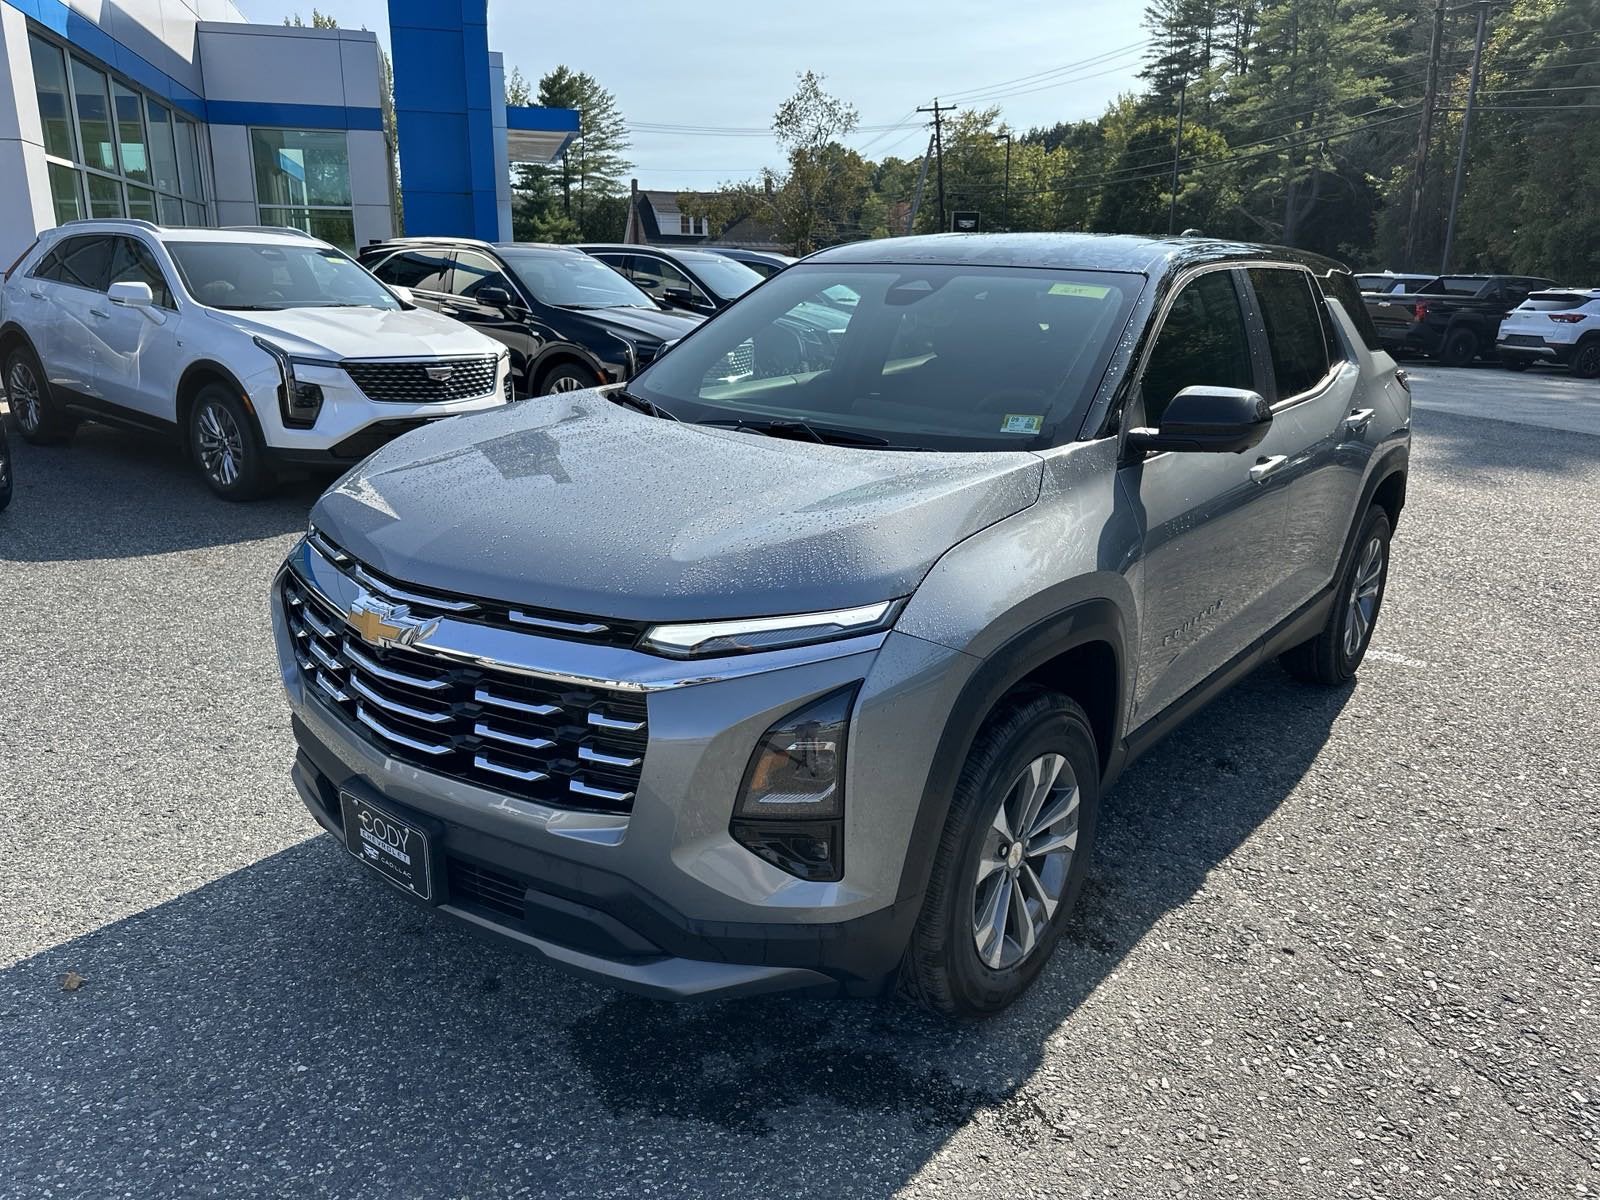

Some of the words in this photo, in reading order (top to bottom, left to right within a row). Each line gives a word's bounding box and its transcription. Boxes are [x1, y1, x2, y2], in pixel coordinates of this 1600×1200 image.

[361, 810, 408, 852] CODY
[361, 830, 408, 862] CHEVROLET
[381, 857, 411, 878] CADILLAC
